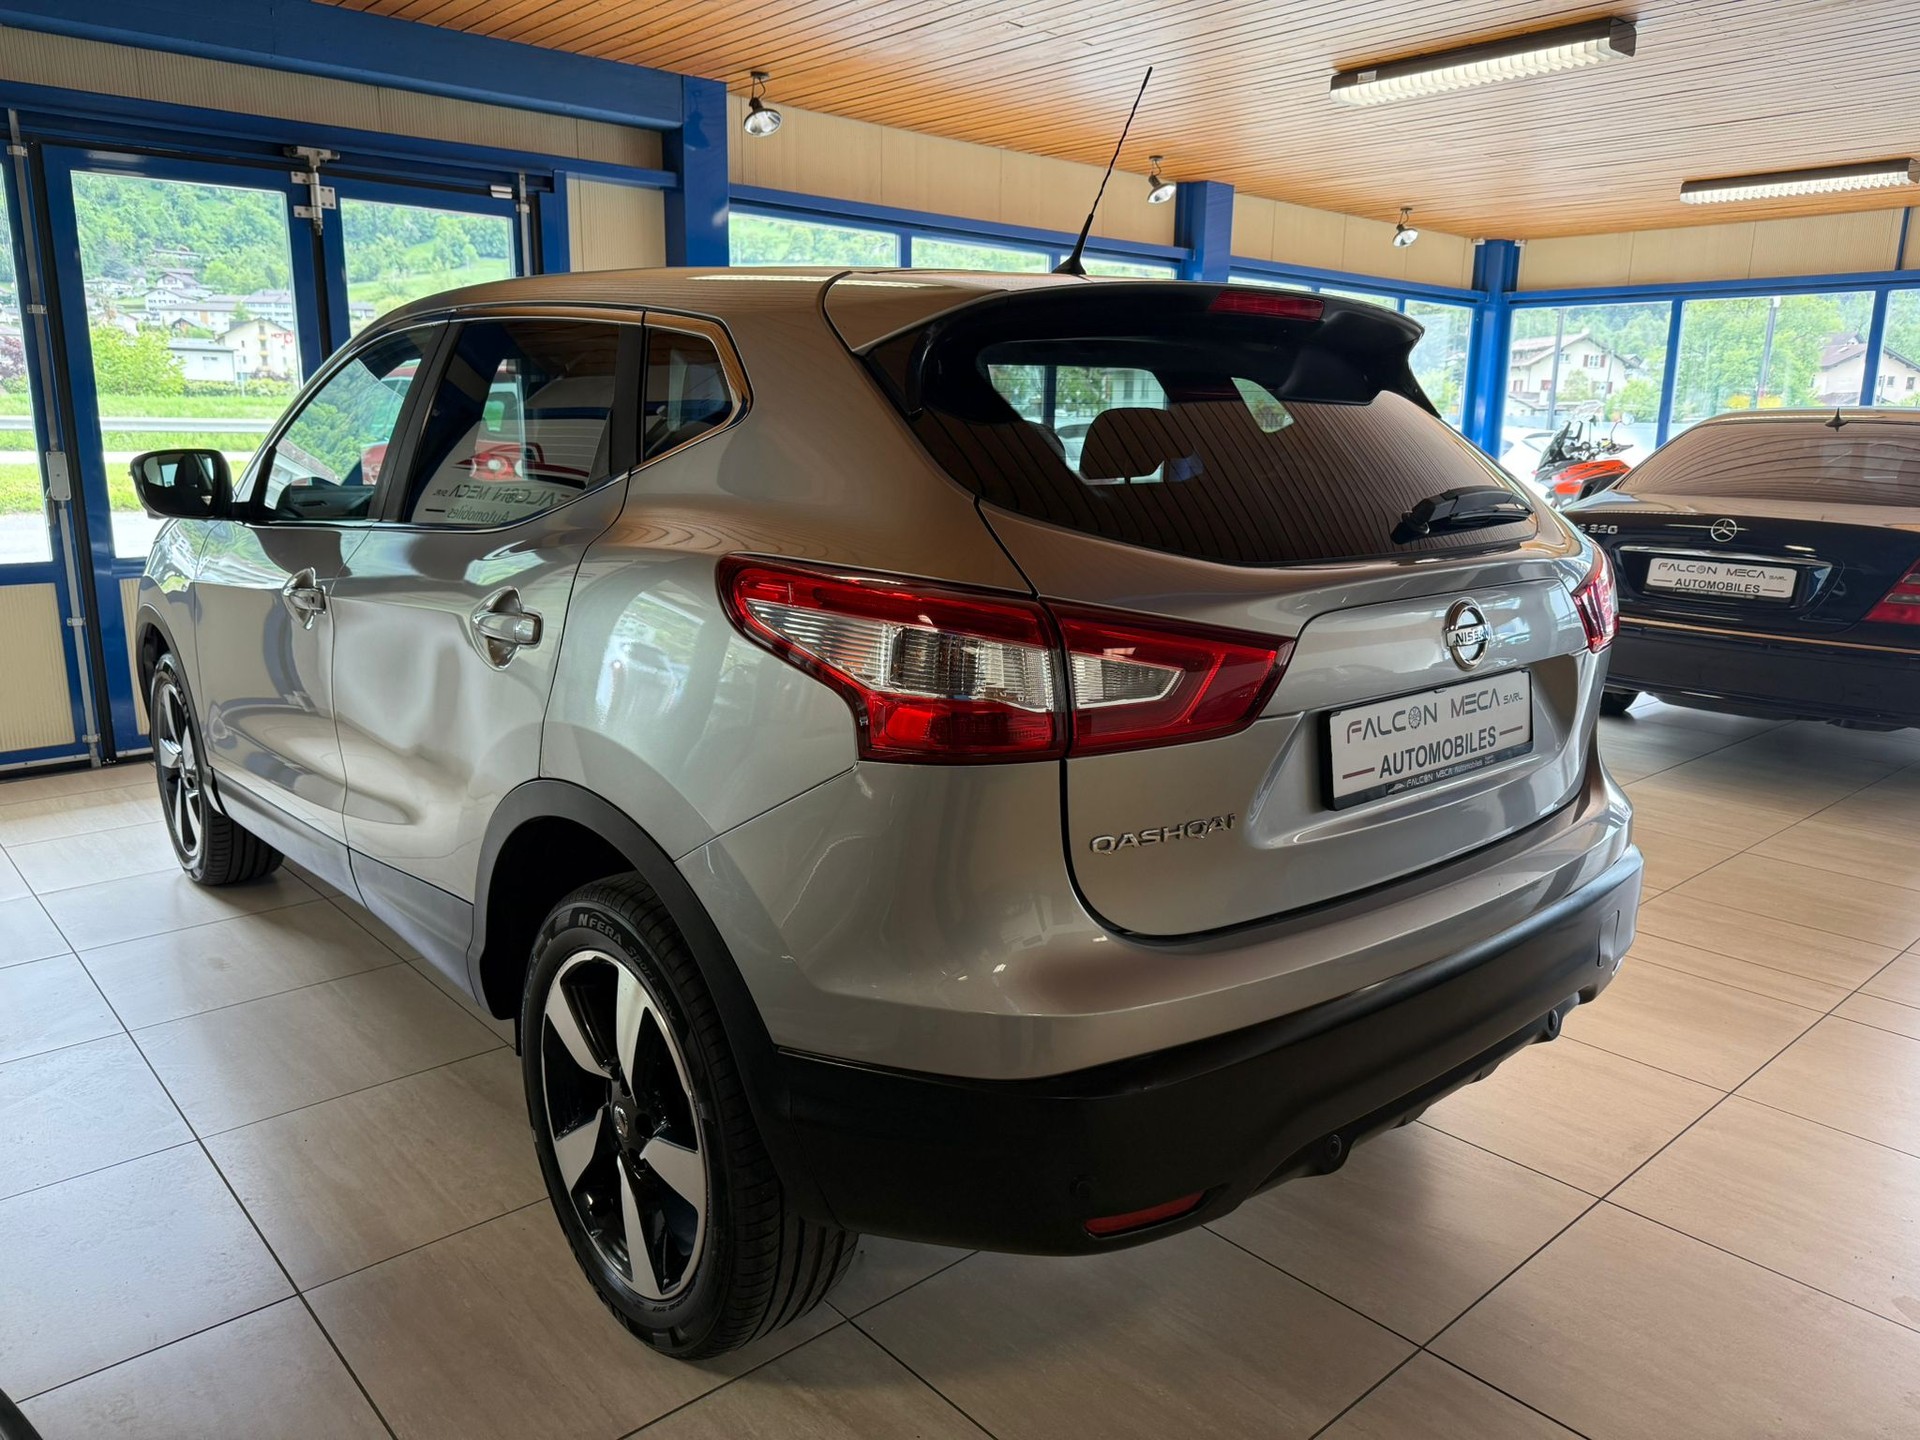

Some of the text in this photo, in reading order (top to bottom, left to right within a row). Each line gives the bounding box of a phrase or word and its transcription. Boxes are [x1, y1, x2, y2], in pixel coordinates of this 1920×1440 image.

[1588, 523, 1619, 535] 320
[1658, 562, 1718, 575] FALCON
[1726, 567, 1766, 579] MECA
[1674, 578, 1761, 594] AUTOMOBILES
[1347, 687, 1524, 744] FALCON MECA SARL
[1379, 725, 1497, 779] AUTOMOBILES
[1406, 772, 1434, 788] FALCON
[1090, 813, 1236, 855] QASHQAI
